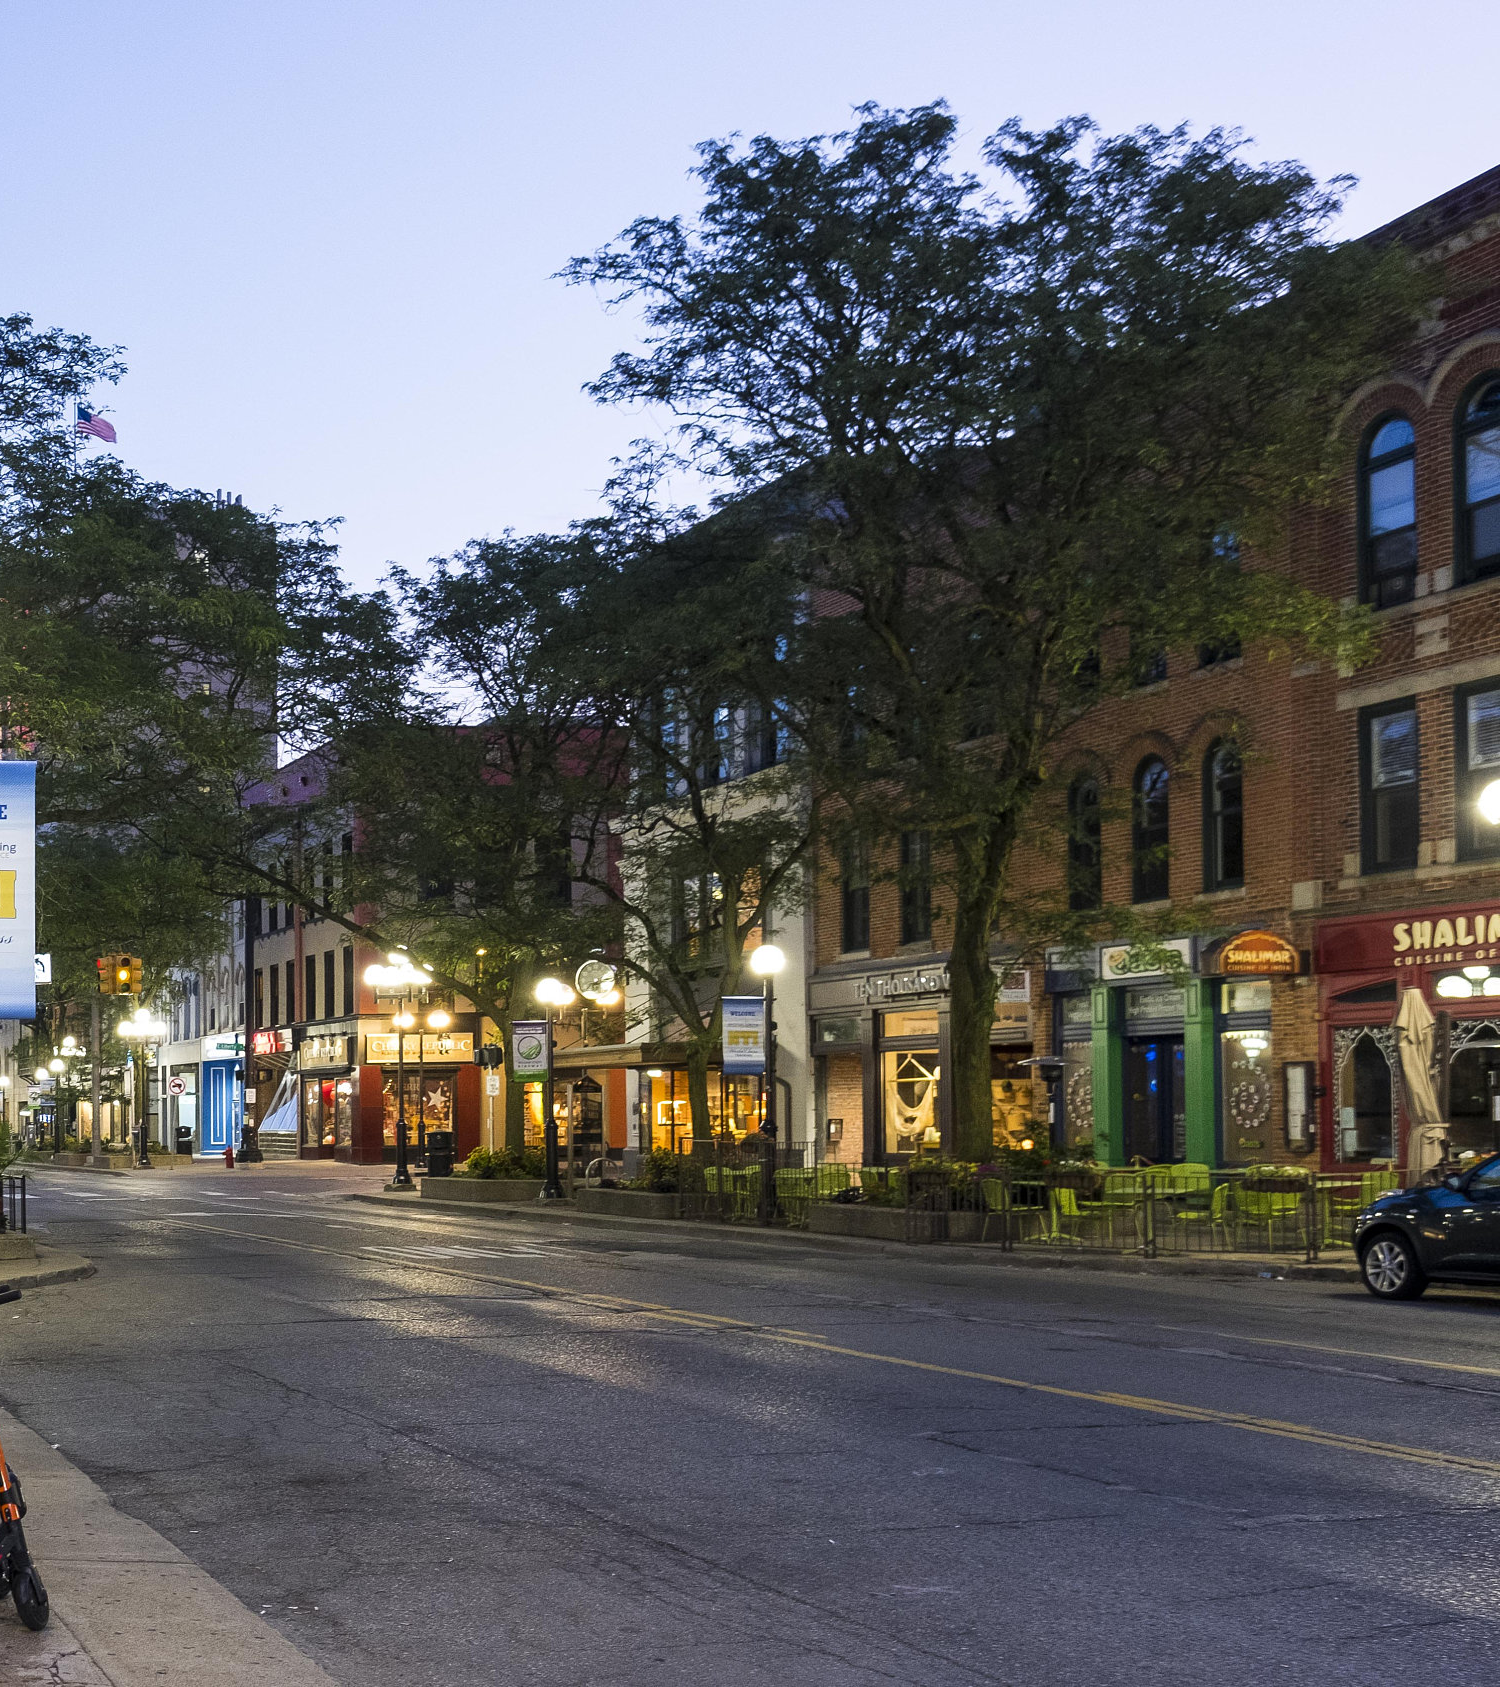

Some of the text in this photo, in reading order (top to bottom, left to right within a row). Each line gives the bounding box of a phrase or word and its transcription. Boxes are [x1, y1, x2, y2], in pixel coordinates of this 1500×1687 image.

[1227, 950, 1292, 963] SHALIMAR
[1393, 948, 1498, 966] CUISINE OF
[853, 981, 874, 999] TEN
[876, 975, 940, 997] THOUSAND
[372, 1039, 471, 1052] CHRY EPULIC
